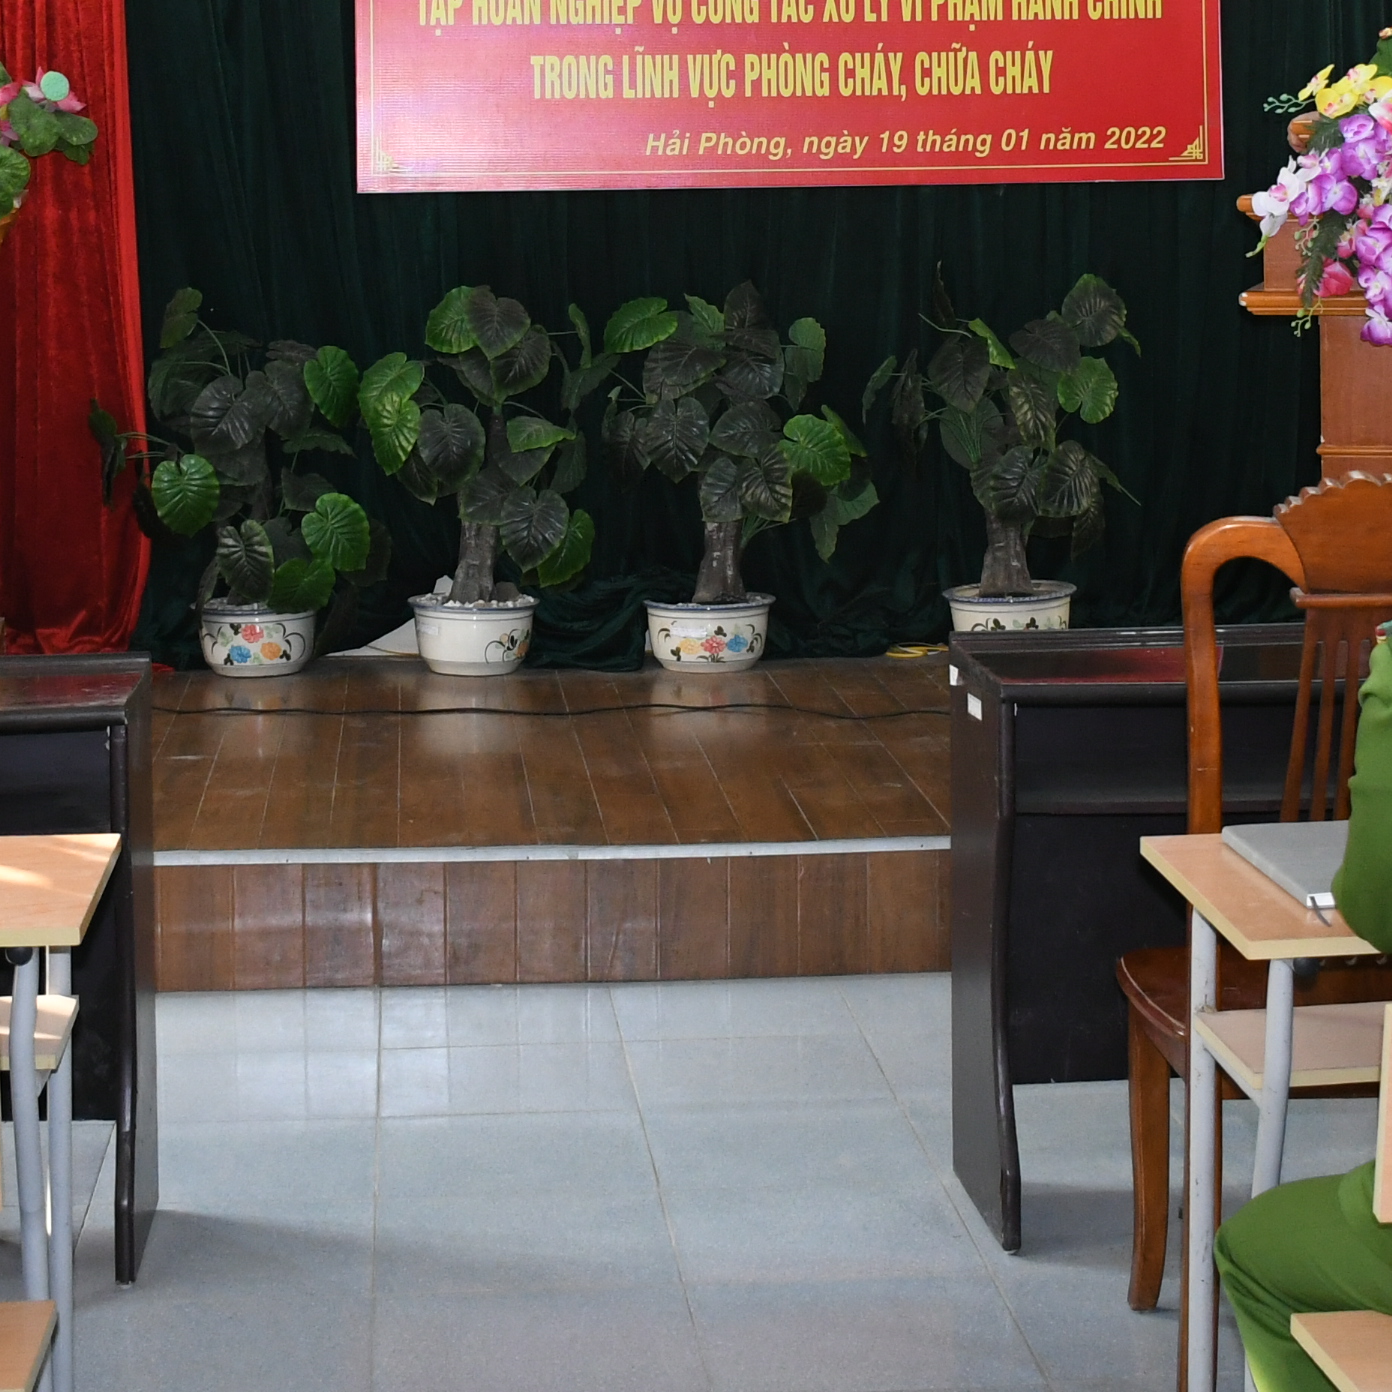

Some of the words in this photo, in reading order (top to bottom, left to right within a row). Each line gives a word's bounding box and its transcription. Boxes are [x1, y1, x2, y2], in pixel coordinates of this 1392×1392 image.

[530, 54, 614, 100] TRONG
[622, 45, 680, 99] LĨNH
[686, 49, 736, 109] VỰC
[744, 41, 830, 98] PHÒNG
[838, 42, 907, 102] CHÁY,
[914, 42, 982, 96] CHỮA
[989, 40, 1053, 95] CHÁY
[645, 128, 691, 157] Hải
[698, 131, 792, 161] Phòng,
[802, 129, 869, 160] ngày
[879, 130, 908, 154] 19
[916, 128, 992, 158] tháng
[1001, 128, 1029, 151] 01
[1040, 127, 1096, 150] năm
[1104, 126, 1168, 150] 2022
